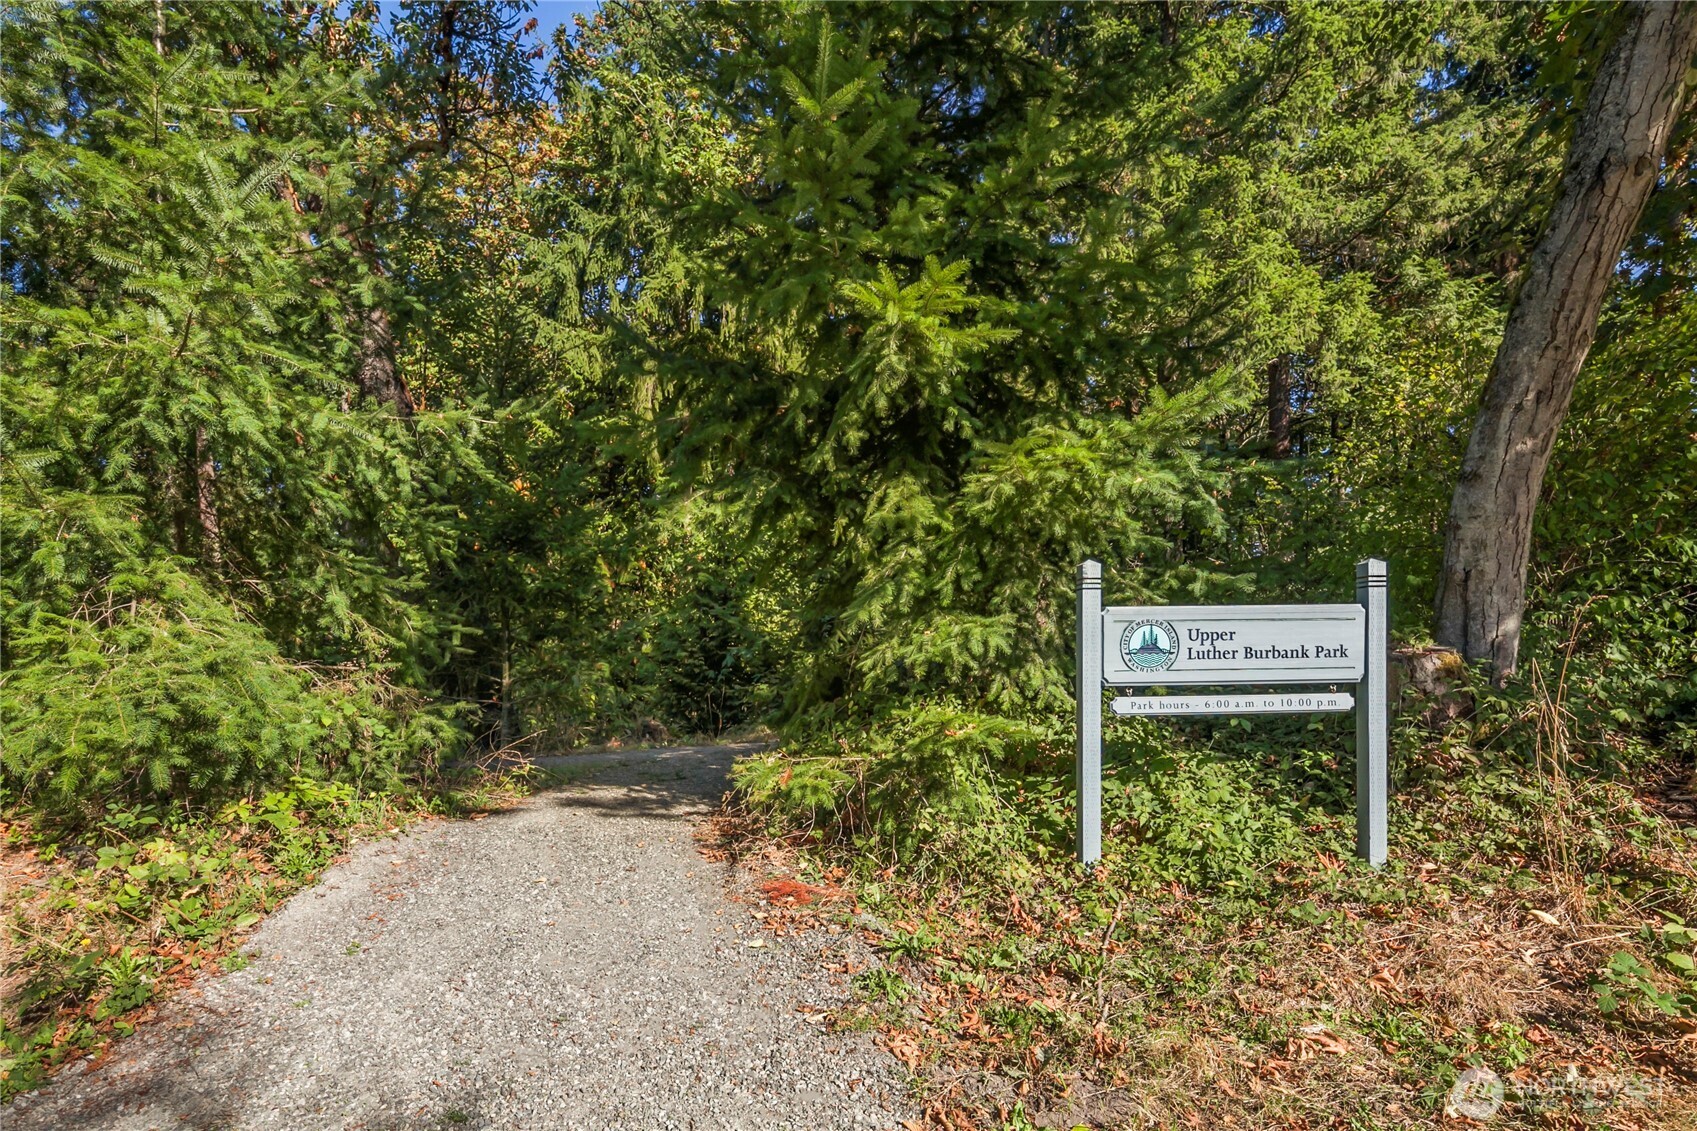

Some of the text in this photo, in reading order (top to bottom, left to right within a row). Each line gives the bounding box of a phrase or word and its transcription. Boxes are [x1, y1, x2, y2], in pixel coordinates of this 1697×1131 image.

[1164, 626, 1176, 650] ISLAND
[1187, 628, 1236, 646] Upper
[1187, 644, 1349, 660] Luther Burbank Park
[1127, 657, 1173, 673] WASHINGTON
[1130, 701, 1154, 710] Park
[1159, 700, 1190, 709] hours
[1204, 699, 1230, 709] 6:00
[1235, 700, 1258, 709] a.m.
[1263, 699, 1275, 708] to
[1280, 698, 1312, 707] 10:00
[1317, 699, 1341, 709] p.m.
